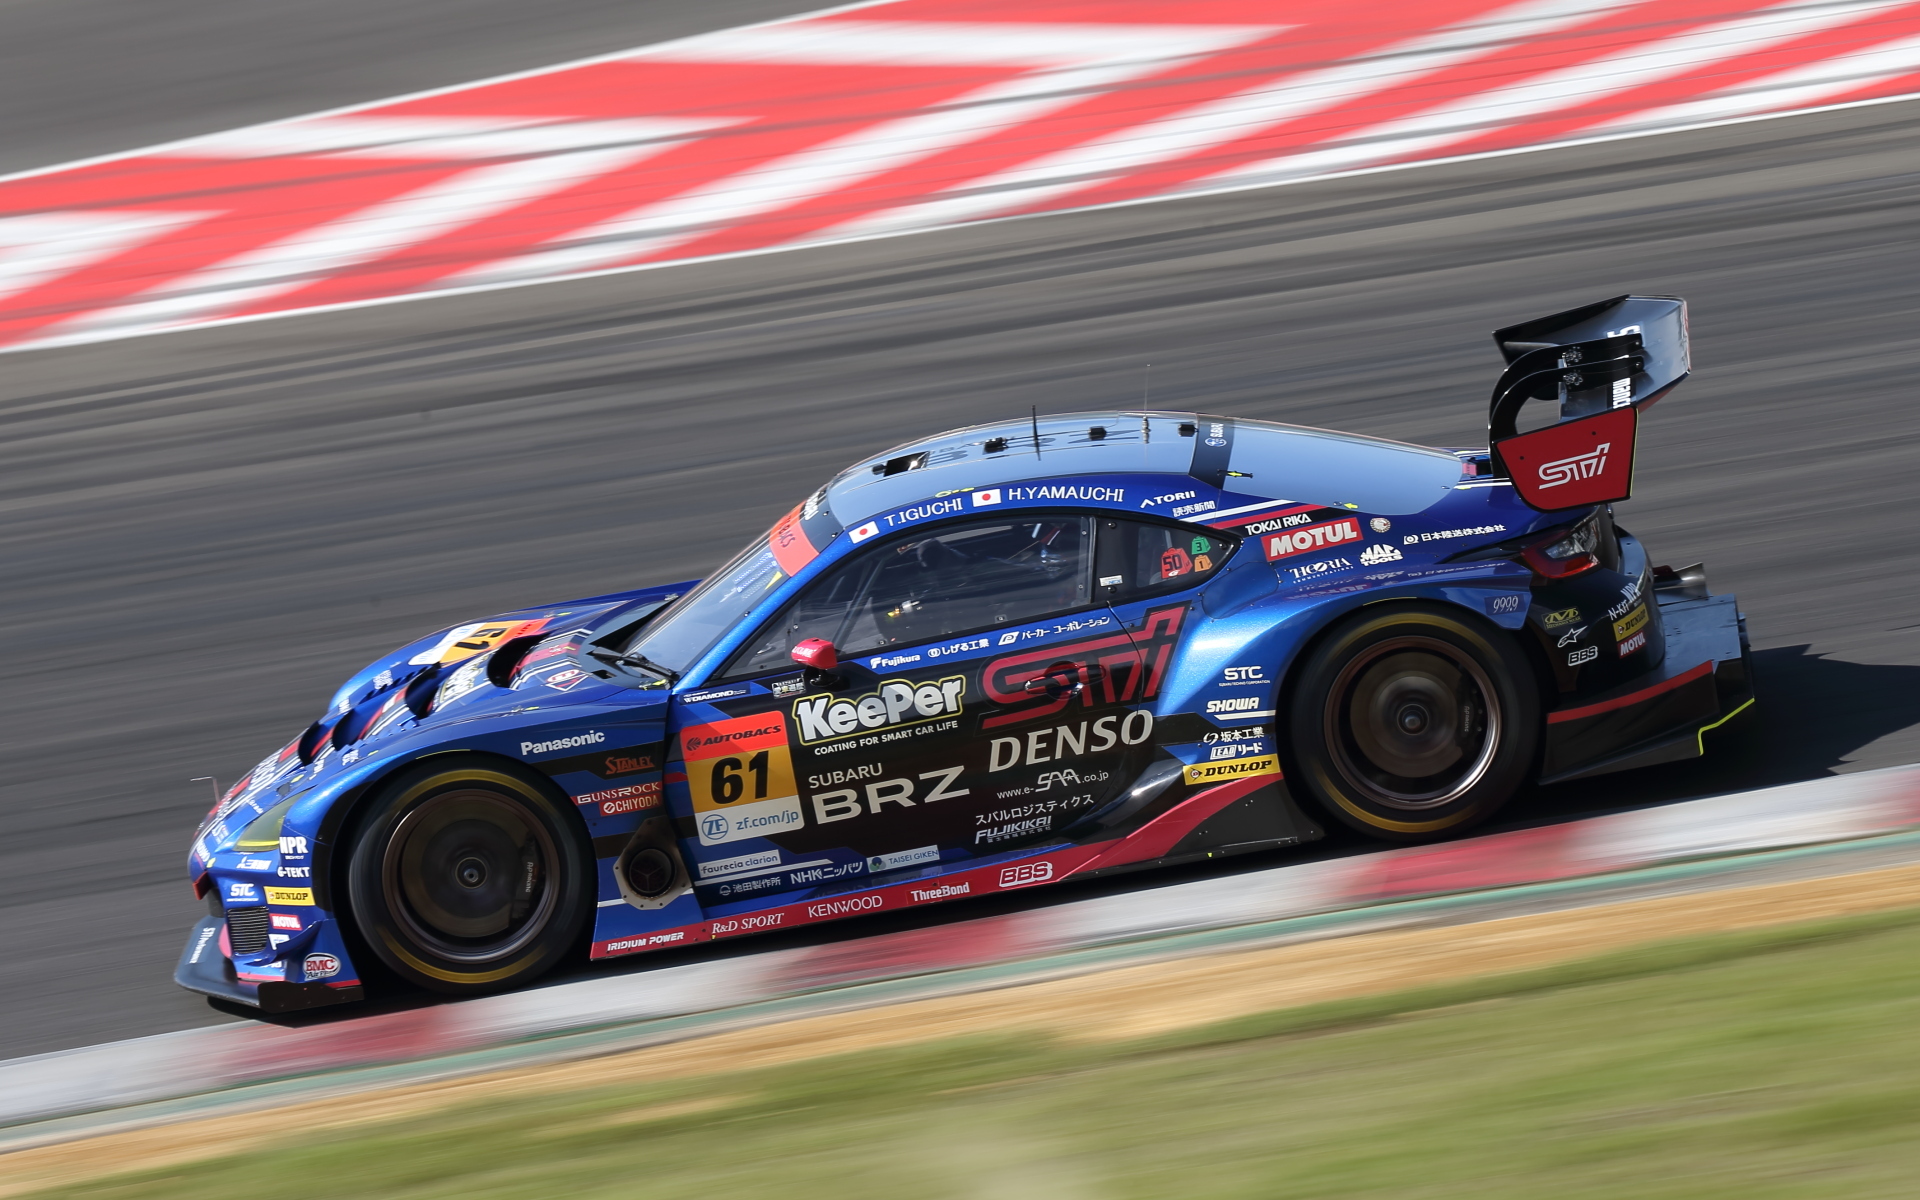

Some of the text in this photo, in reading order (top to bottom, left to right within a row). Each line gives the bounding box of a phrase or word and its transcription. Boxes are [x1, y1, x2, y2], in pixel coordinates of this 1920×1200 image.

[1008, 486, 1125, 502] H.YAMAUCHI
[884, 497, 963, 527] T.IGUCHI
[1245, 513, 1312, 536] TOKAI RIKA
[1195, 541, 1203, 552] 3
[1270, 521, 1358, 558] MOTUL
[1162, 553, 1183, 572] 50
[1198, 560, 1204, 569] 1
[1053, 616, 1111, 634] コーポレーション
[1620, 631, 1646, 657] MOTUL
[881, 653, 921, 668] Fujikura
[1568, 645, 1598, 666] BBS
[1224, 665, 1263, 681] STC
[797, 679, 961, 741] KeePer
[1206, 696, 1260, 713] SHOWA
[520, 730, 606, 756] Panasonic
[702, 724, 782, 747] AUTOBACS
[814, 720, 958, 756] COATING FOR SMART CAR LIFE
[988, 709, 1154, 773] DENSO
[1220, 726, 1265, 743] 坂本工業
[1213, 742, 1263, 758] LEAD リード
[605, 756, 655, 775] STANLEY
[808, 762, 883, 789] SUBARU
[1204, 759, 1273, 777] DUNLOP
[710, 750, 769, 805] 61
[615, 795, 660, 813] CHIYODA
[811, 765, 970, 825] BRZ
[975, 794, 1095, 825] スバルロジスティクス
[736, 809, 799, 832] zf.com/jp
[974, 816, 1052, 844] FUJIKIKAI
[279, 836, 309, 854] NPR
[702, 855, 778, 875] faurecia clarion
[888, 849, 939, 866] TAISEI GIKEN
[999, 861, 1053, 888] BBS
[230, 883, 255, 897] STC
[275, 891, 309, 901] DUNLOP
[911, 881, 970, 903] ThreeBond
[808, 895, 883, 919] KENWOOD
[271, 915, 301, 929] MOTUL
[711, 912, 785, 934] R&D SPORT
[607, 931, 685, 952] IRIDIUM POWER
[306, 958, 336, 972] BMC
